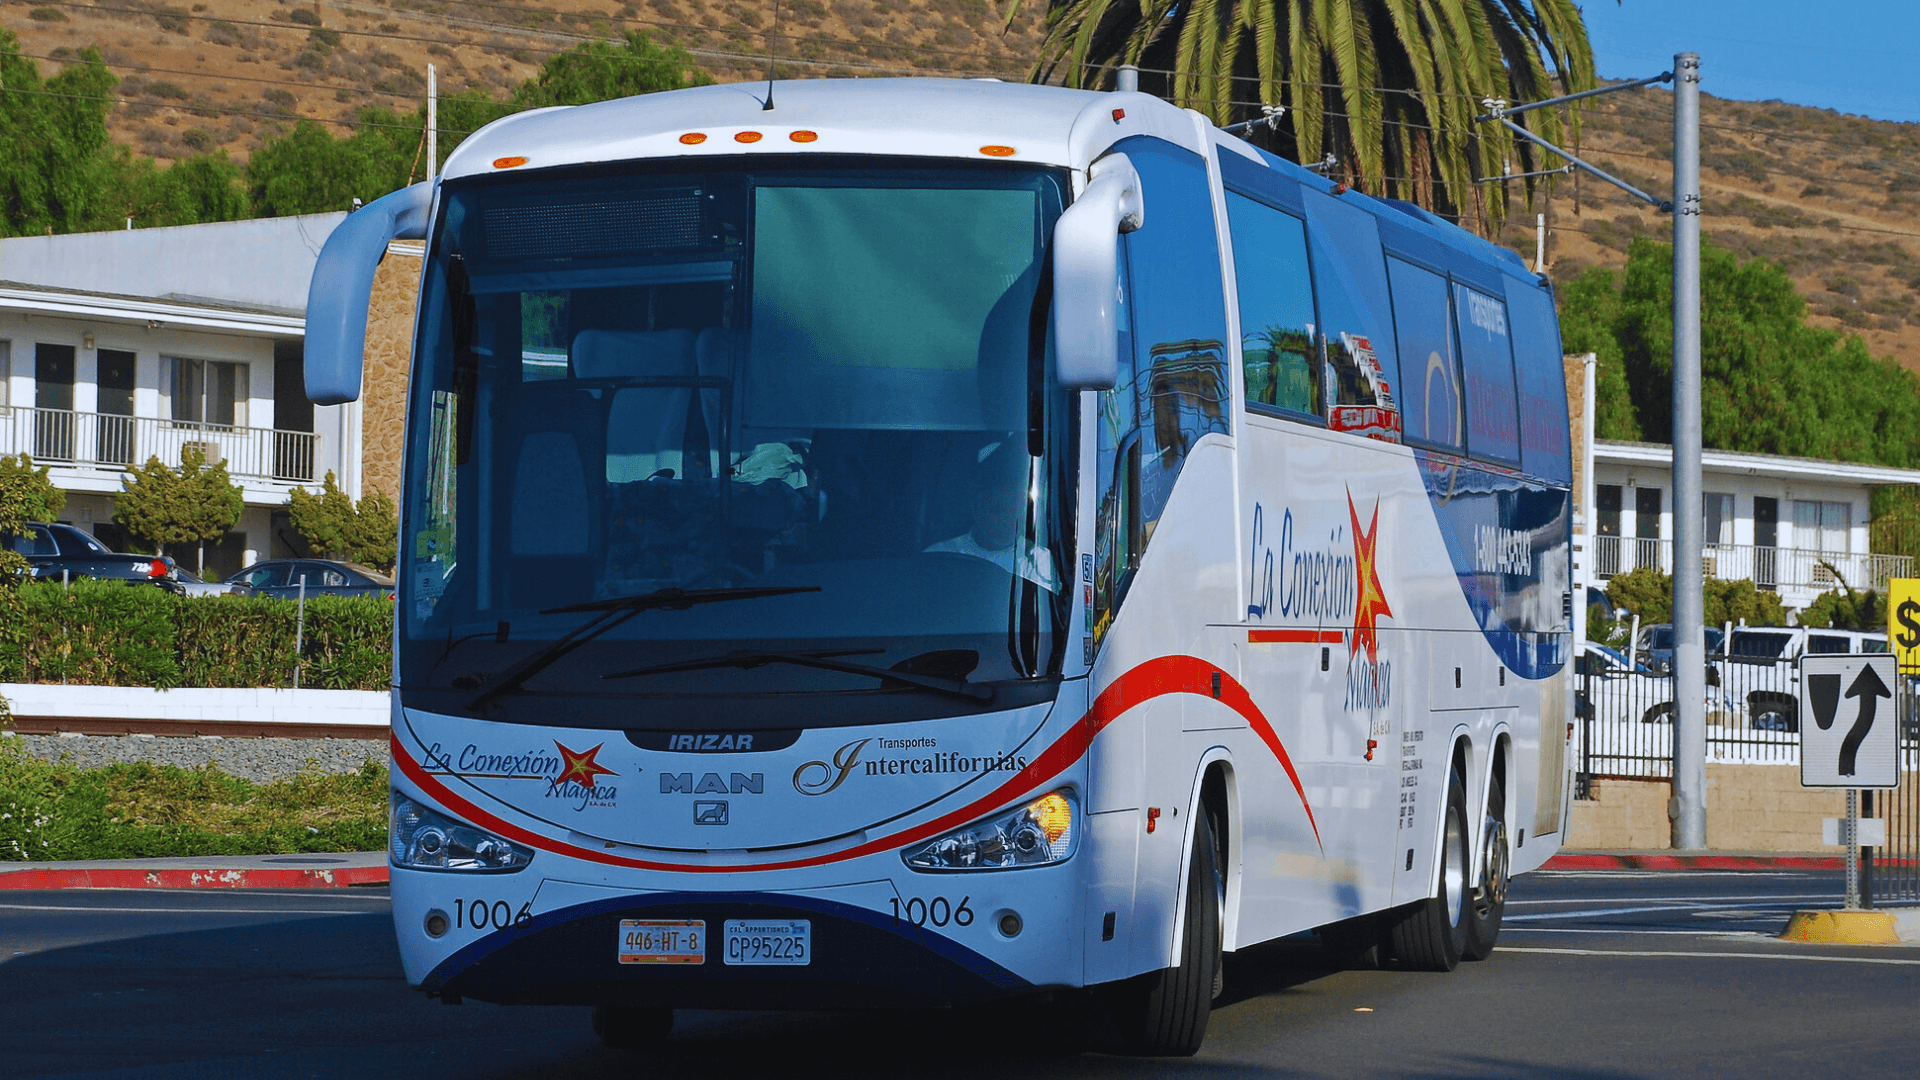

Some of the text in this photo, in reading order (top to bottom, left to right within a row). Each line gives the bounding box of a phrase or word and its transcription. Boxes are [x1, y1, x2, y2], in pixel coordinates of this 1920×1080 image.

[1247, 501, 1353, 628] La Conexión
[1474, 524, 1496, 573] 1-800
[1895, 596, 1920, 653] $
[669, 734, 754, 750] IRIZAR
[878, 737, 936, 750] Transportes
[420, 742, 559, 779] La Conexión
[660, 773, 763, 794] MAN
[454, 898, 534, 930] 1006
[889, 895, 974, 928] 1006
[625, 931, 698, 950] 446-HT-8
[729, 936, 804, 959] CP95225
